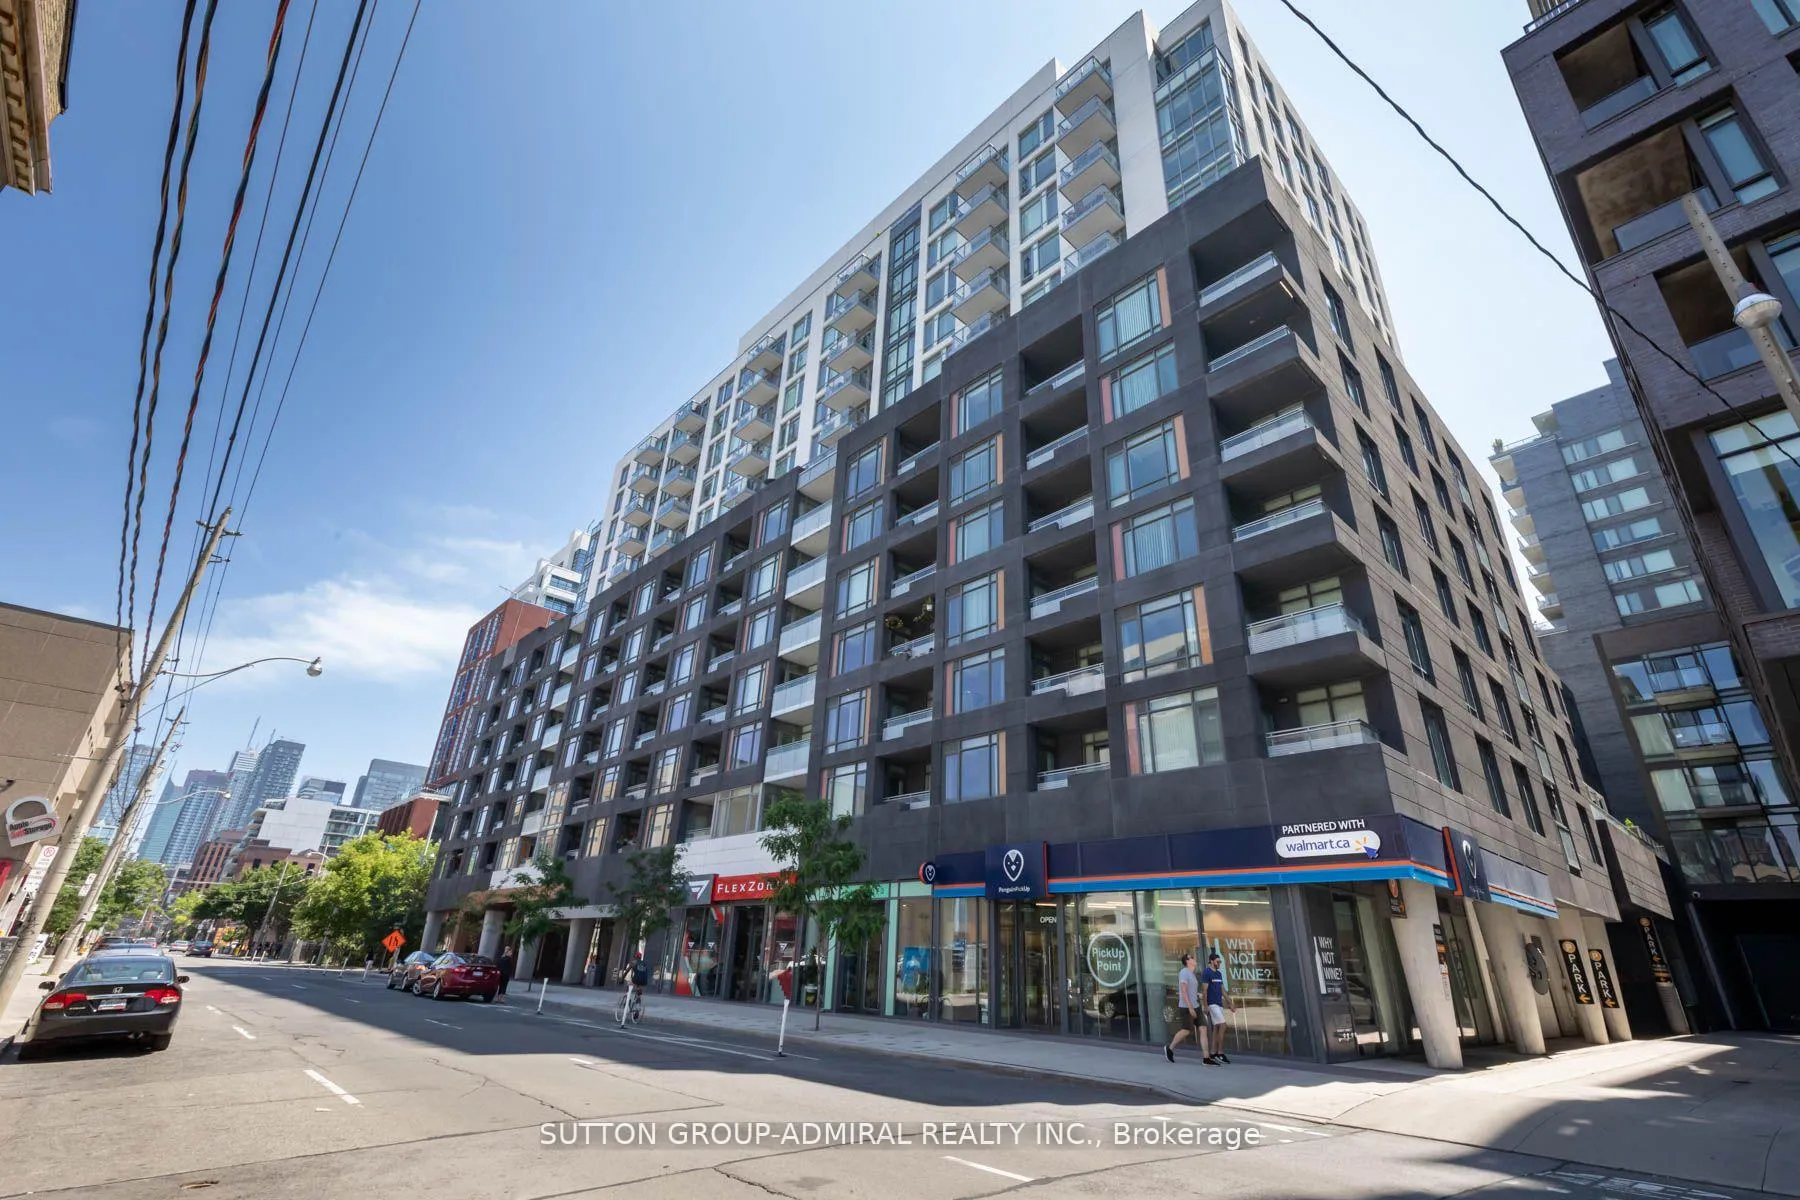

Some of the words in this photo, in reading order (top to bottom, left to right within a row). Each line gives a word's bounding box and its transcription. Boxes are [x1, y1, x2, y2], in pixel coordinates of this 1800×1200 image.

[1282, 821, 1336, 834] PARTNERED
[1337, 818, 1365, 830] WITH
[1286, 839, 1350, 852] walmart.ca
[1039, 916, 1057, 924] OPEN
[1226, 938, 1257, 951] WHY
[1318, 936, 1333, 949] WHY
[1092, 947, 1126, 961] PickUp
[1228, 952, 1257, 966] NOT
[1321, 951, 1335, 964] NOT
[1097, 960, 1122, 972] Point
[1229, 967, 1272, 981] WINE?
[1323, 967, 1343, 980] WINE?
[1568, 954, 1587, 994] PARK
[1594, 961, 1612, 999] PARK
